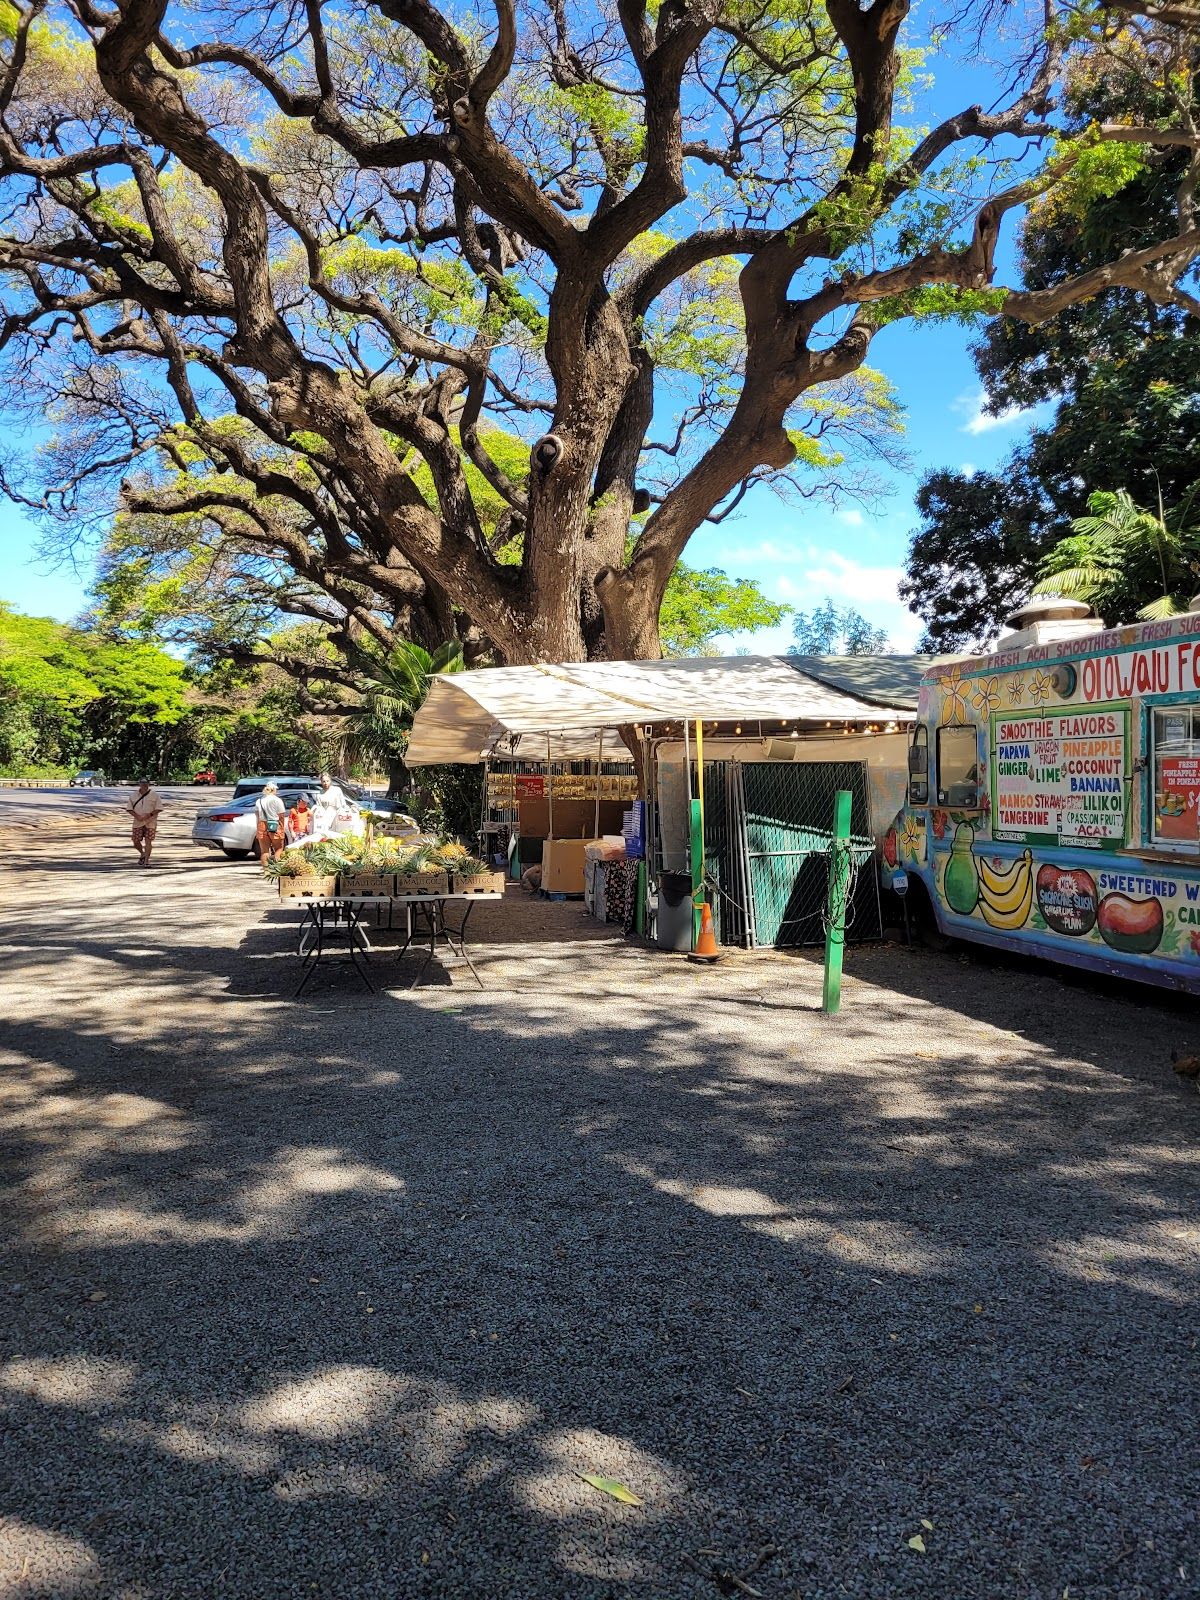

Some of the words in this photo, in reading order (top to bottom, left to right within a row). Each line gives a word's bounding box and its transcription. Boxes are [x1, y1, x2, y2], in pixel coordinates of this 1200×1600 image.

[1141, 621, 1173, 641] FRESH
[987, 652, 1020, 668] FRESH
[1026, 646, 1049, 662] ACAI
[1056, 632, 1118, 657] SMOOTHIES
[1000, 720, 1054, 740] SMOOTHIE
[1060, 715, 1116, 737] FLAVORS
[999, 744, 1031, 760] PAPAYA
[1063, 739, 1122, 758] PINEAPPLE
[1033, 740, 1060, 754] DRAGON
[1039, 753, 1058, 765] FRUIT
[1178, 760, 1199, 769] FRESH
[998, 761, 1029, 776] GINGER
[1035, 767, 1061, 783] LIME
[1068, 759, 1122, 775] COCONUT
[1163, 769, 1197, 778] PINEAPPLE
[1070, 776, 1122, 793] BANANA
[1168, 777, 1176, 786] IN
[999, 794, 1034, 809] MANGO
[1083, 795, 1122, 812] LILIKOI
[999, 810, 1050, 826] TANGERINE
[1066, 811, 1100, 826] (PASSION
[310, 880, 331, 888] GOLD
[1099, 873, 1177, 898] SWEETENED
